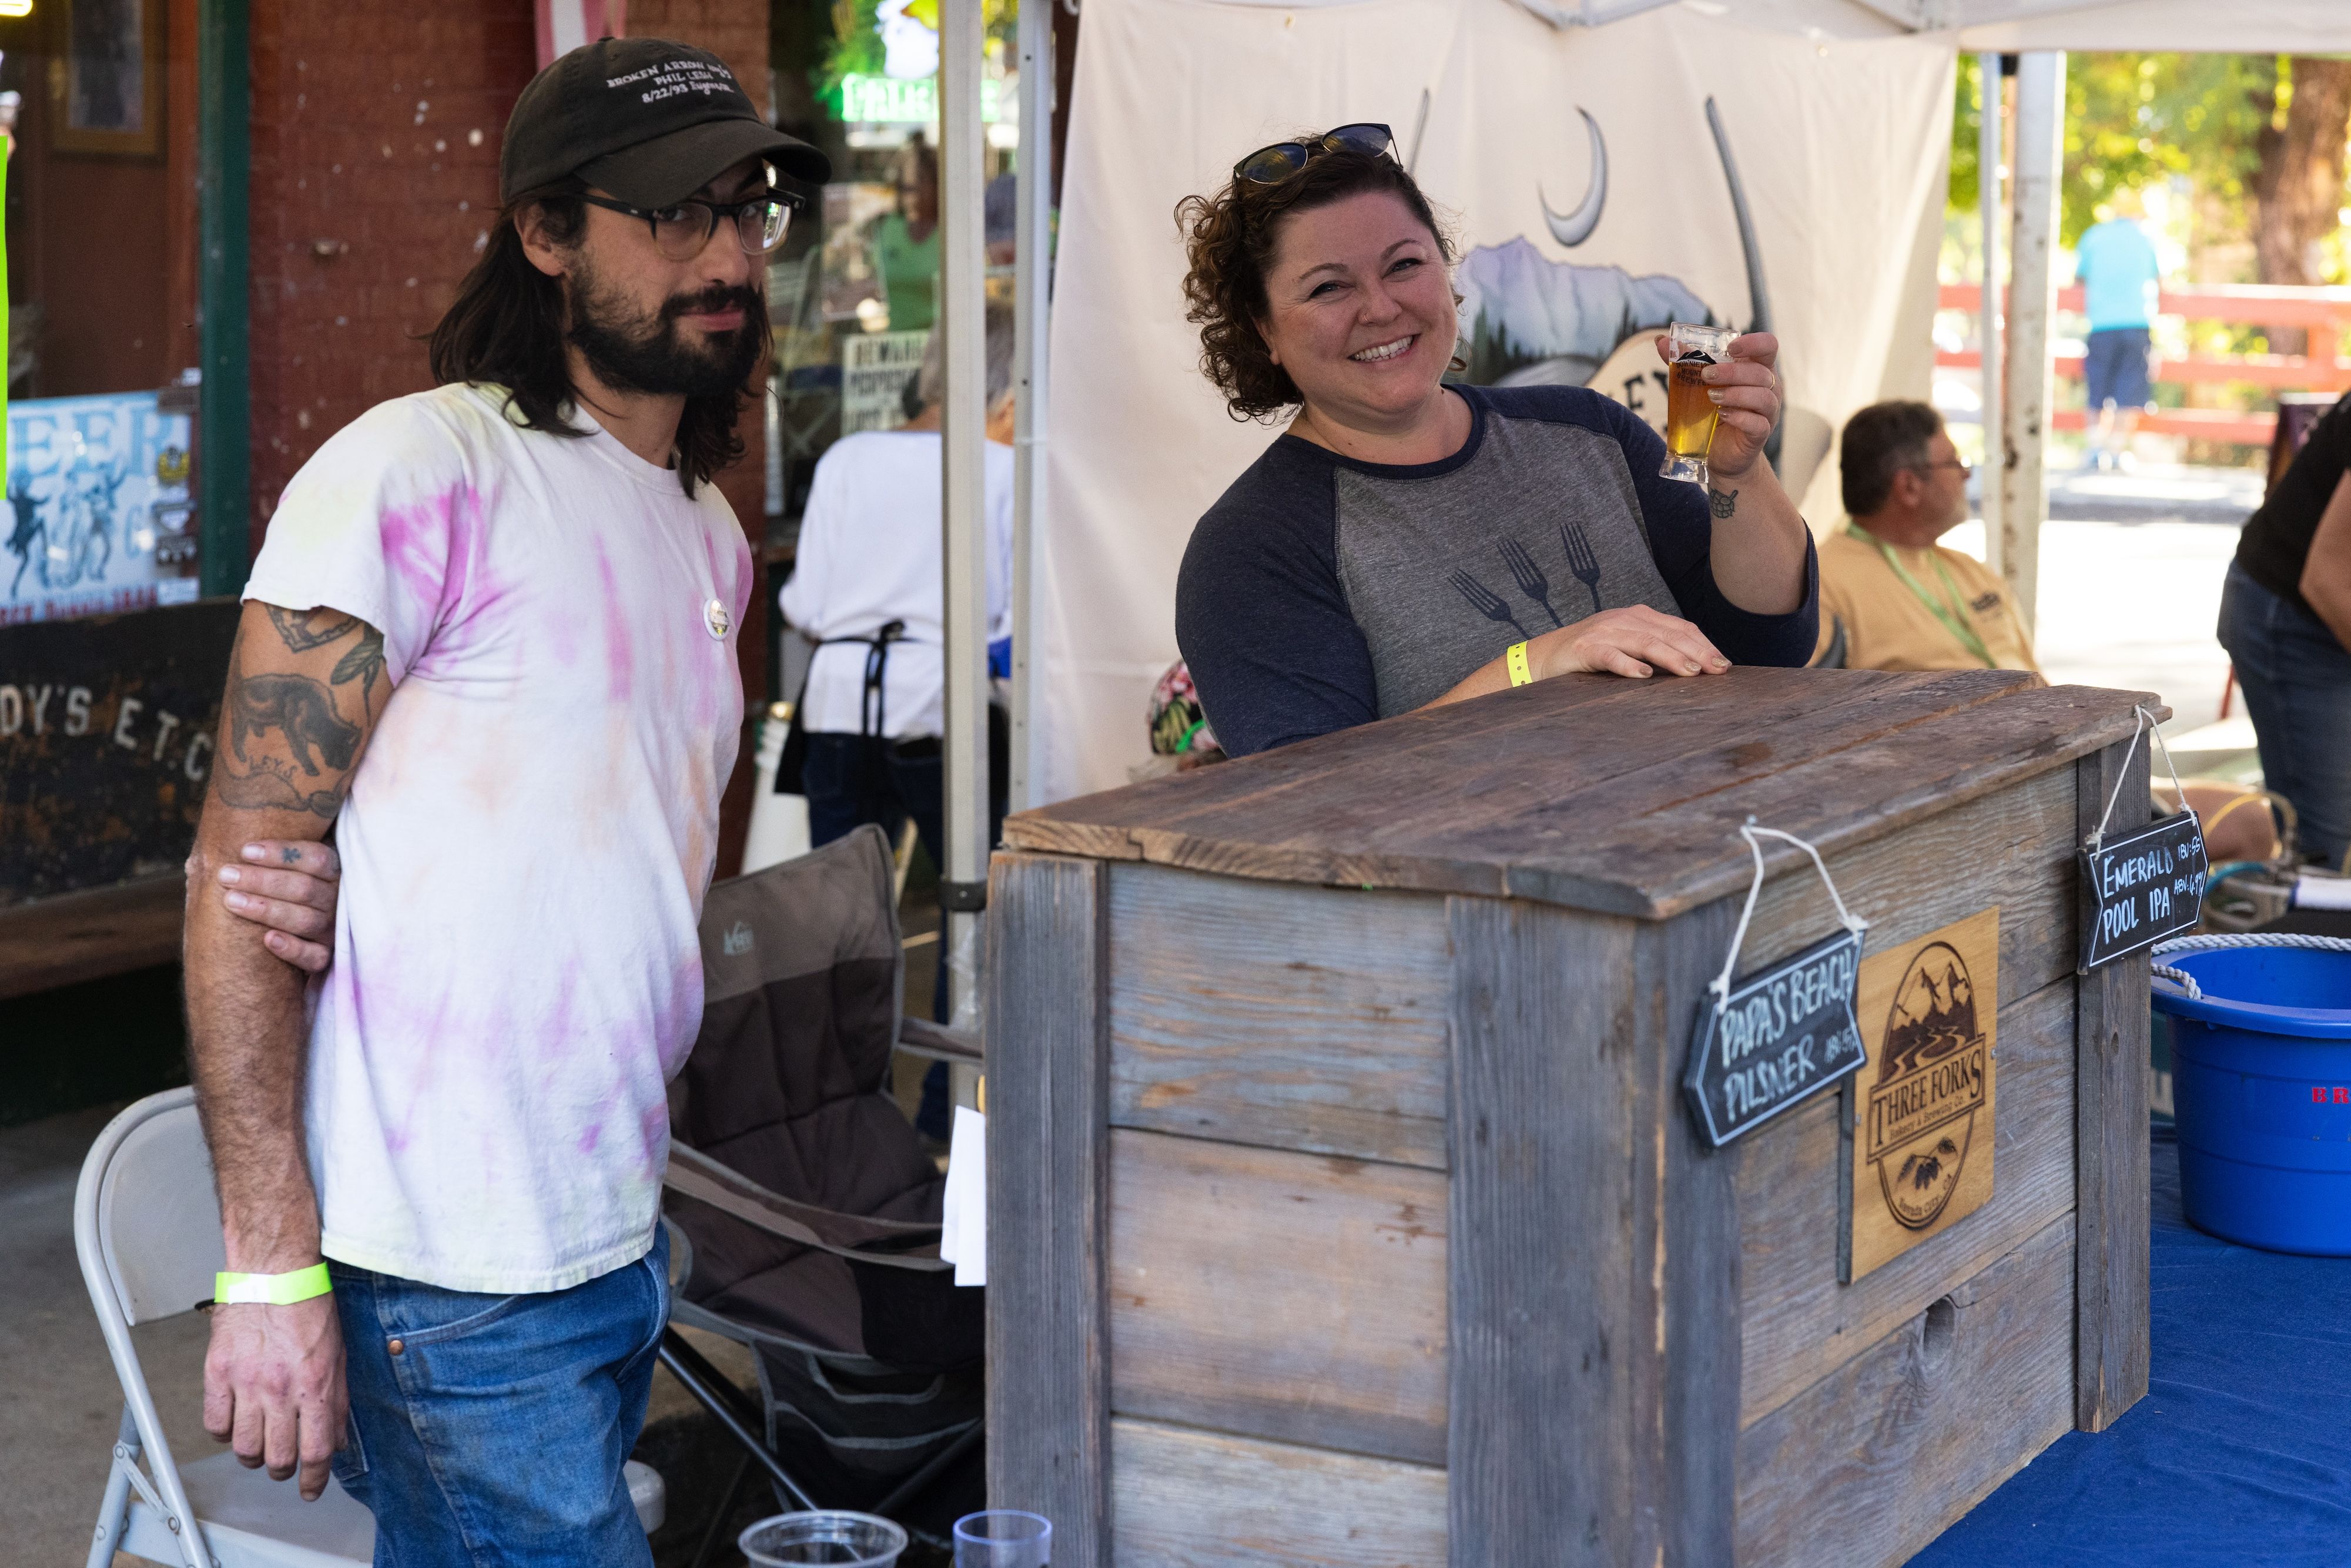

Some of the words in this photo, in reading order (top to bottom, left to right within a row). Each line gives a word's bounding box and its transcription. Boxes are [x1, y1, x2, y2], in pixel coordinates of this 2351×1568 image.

[607, 64, 659, 88] BROKEN
[664, 61, 705, 72] ARROW
[653, 72, 686, 85] PHIL
[2104, 846, 2173, 898] EMERALD
[2103, 896, 2139, 945] POOL
[2149, 886, 2170, 922] IPA
[1720, 981, 1787, 1068] PAPA'S
[1790, 947, 1852, 1024] BEACH
[1723, 1034, 1816, 1123] PILSNER
[1873, 1074, 1928, 1146] THREE
[1931, 1048, 1981, 1104] FORKS
